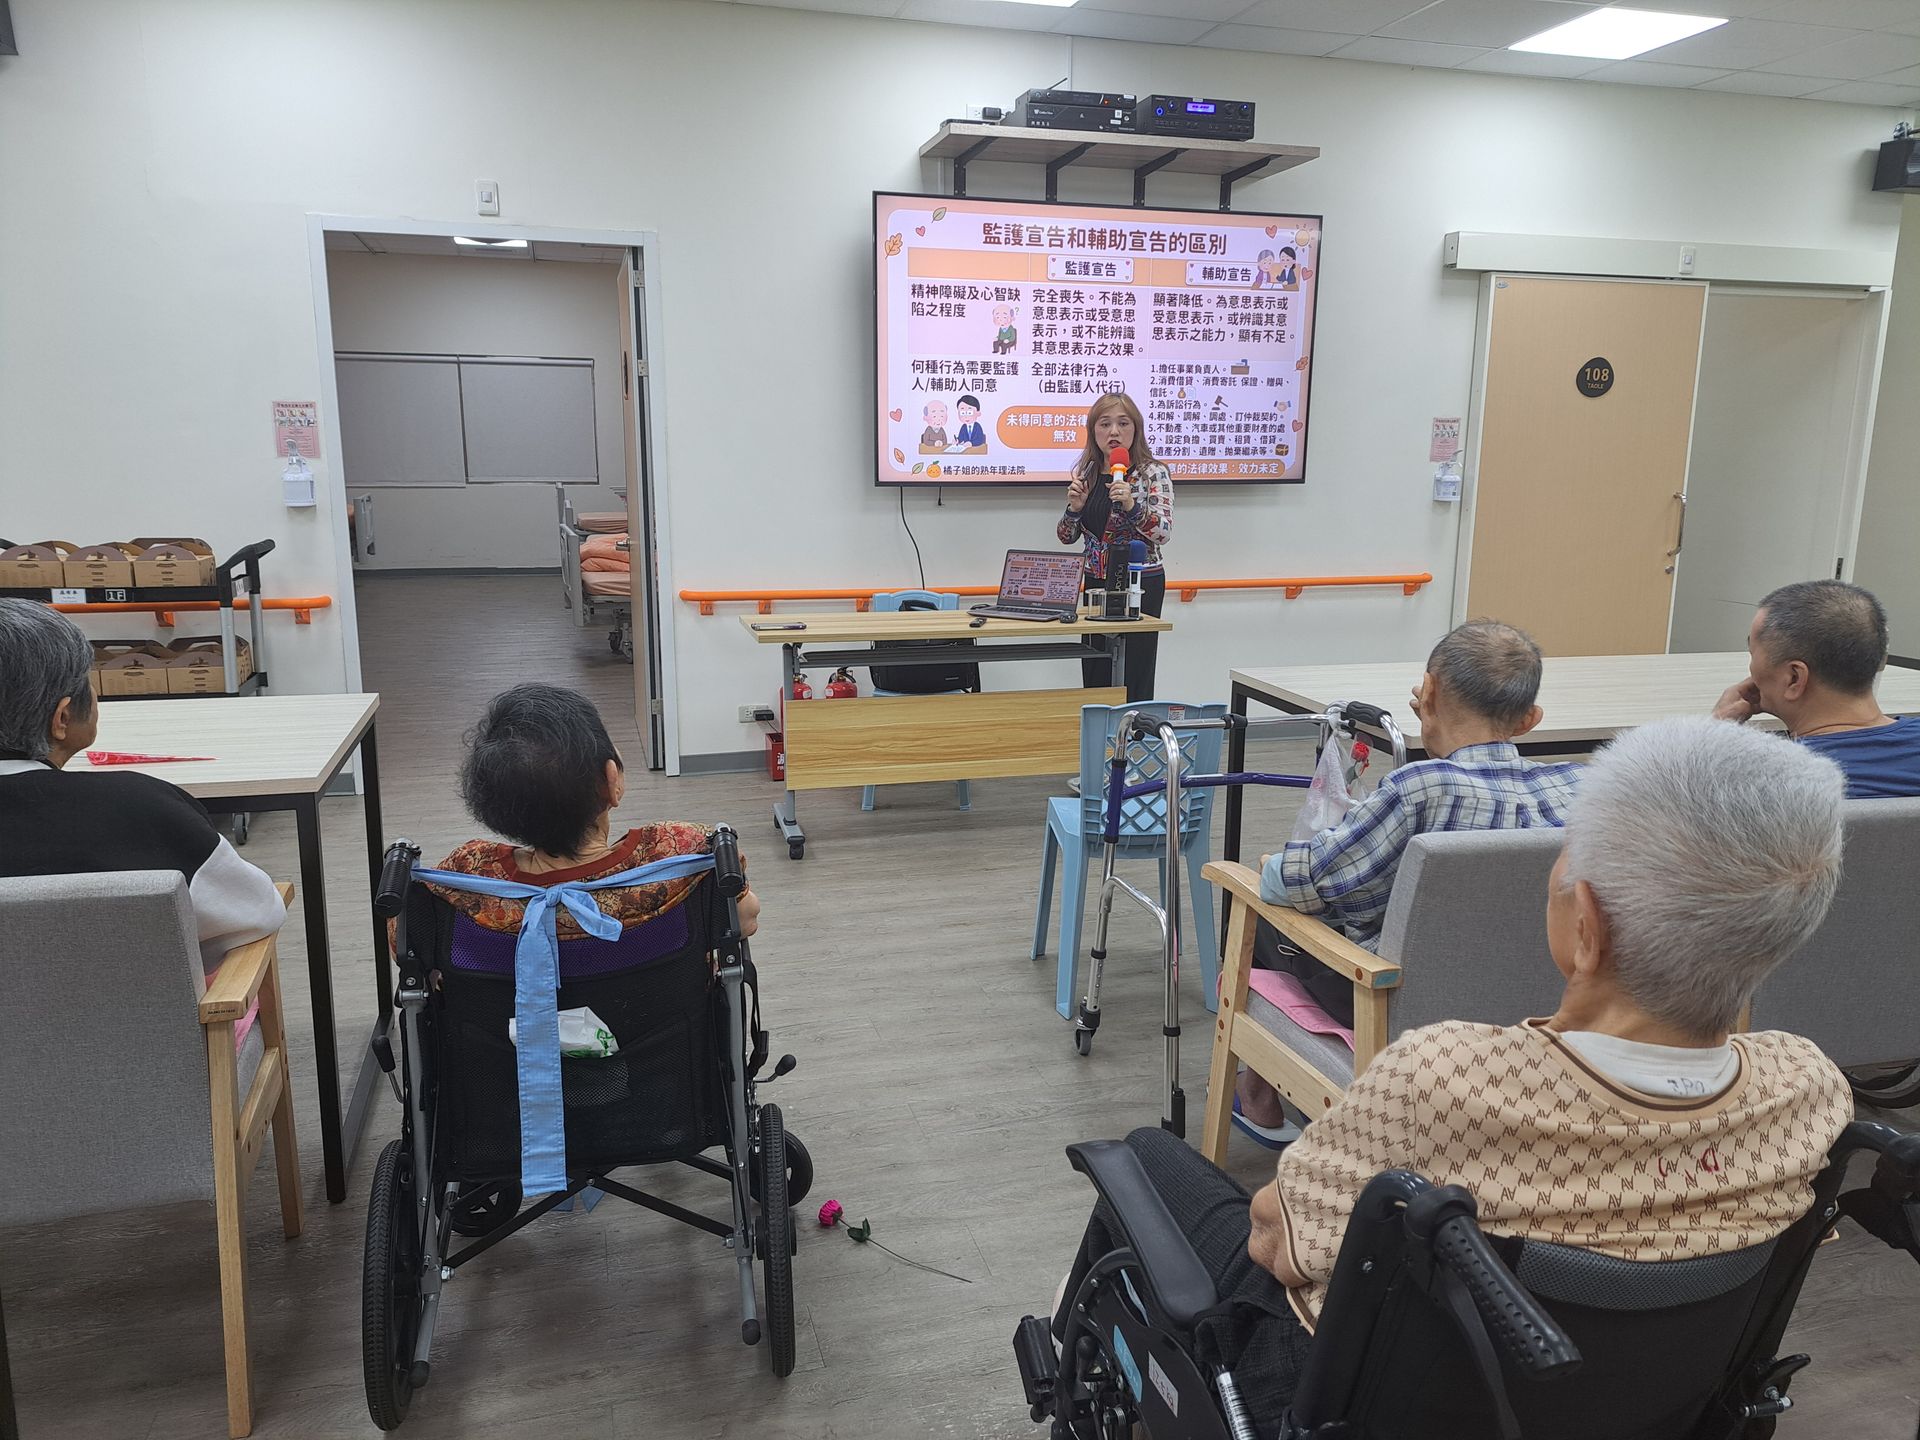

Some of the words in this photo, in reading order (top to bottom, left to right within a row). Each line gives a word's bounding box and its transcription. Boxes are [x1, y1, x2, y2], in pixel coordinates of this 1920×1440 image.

[982, 222, 1227, 255] 監護宣告和輔助宣告的區別
[1064, 260, 1117, 277] 監護宣告
[1202, 266, 1252, 282] 輔助宣告
[911, 283, 1021, 302] 精神障礙及心智缺
[1032, 288, 1137, 306] 完全喪失。不能為
[1153, 292, 1289, 310] 顯著降低。為意思表示或
[911, 302, 966, 318] 陷之程度
[1032, 306, 1136, 323] 意思表示或受意思
[1031, 340, 1144, 357] 其意思表示之效果。
[911, 359, 1020, 376] 何種行為需要監護
[1031, 362, 1118, 377] 全部法律行為。
[1585, 367, 1610, 382] 108
[911, 376, 998, 393] 人/輔助人同意
[1053, 430, 1077, 443] 無效
[108, 591, 124, 600] 1F
